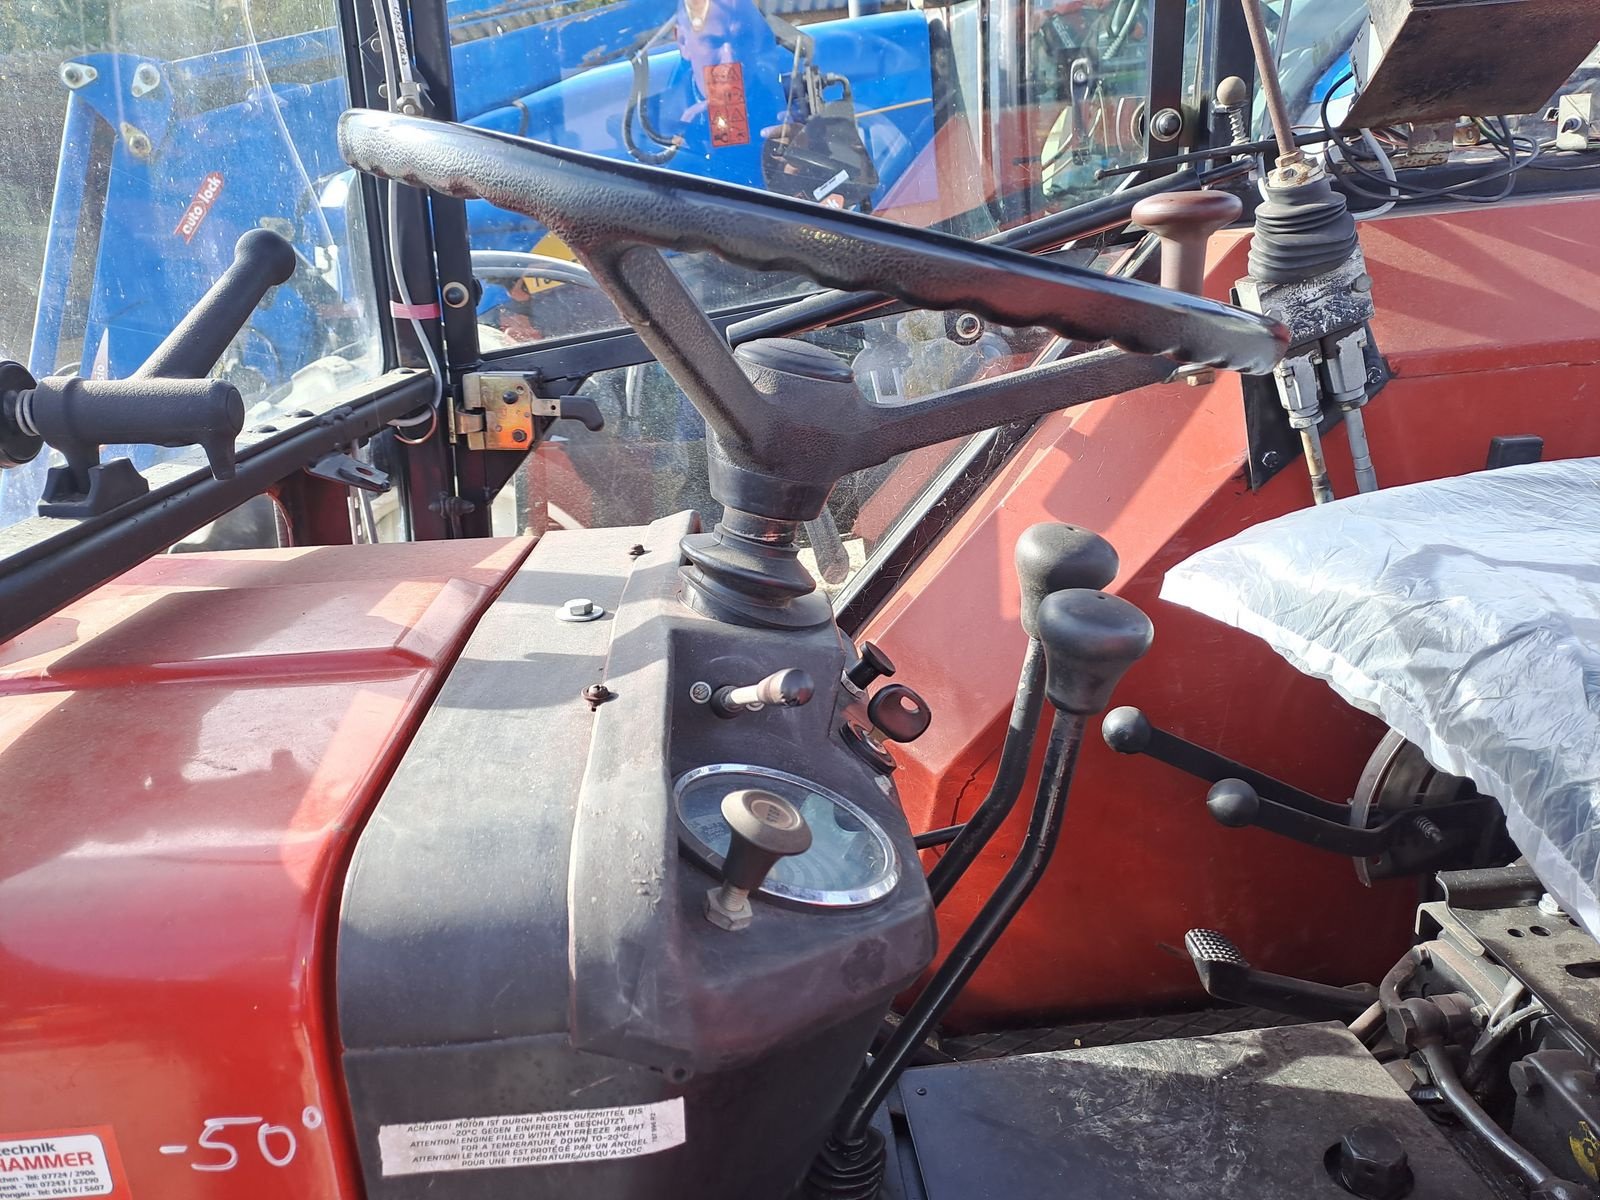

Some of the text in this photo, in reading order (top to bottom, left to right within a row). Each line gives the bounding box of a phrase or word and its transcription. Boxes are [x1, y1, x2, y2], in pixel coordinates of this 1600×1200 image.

[182, 176, 221, 234] auto lock
[407, 1123, 452, 1132] ACHTUNG!
[536, 1110, 625, 1122] FROSTSCHUTZMITTEL
[628, 1108, 643, 1116] BIS
[482, 1127, 511, 1135] GEGEN
[515, 1122, 569, 1132] EINFRIEREN
[574, 1118, 625, 1129] GESCHÜTZT
[410, 1138, 459, 1147] ATTENTION!
[461, 1135, 494, 1144] ENGINE
[528, 1131, 551, 1139] WITH
[554, 1126, 610, 1137] ANTIFREEZE
[614, 1123, 645, 1132] AGENT
[491, 1138, 556, 1149] TEMPERATURE
[560, 1136, 588, 1144] DOWN
[0, 1143, 56, 1156] echnik
[412, 1153, 460, 1163] ATTENTION!
[474, 1150, 510, 1159] MOTEUR
[513, 1148, 528, 1156] EST
[530, 1143, 571, 1154] PROTÉGÉ
[573, 1143, 592, 1151] PAR
[612, 1139, 648, 1148] ANTIGEL
[462, 1159, 485, 1167] POUR
